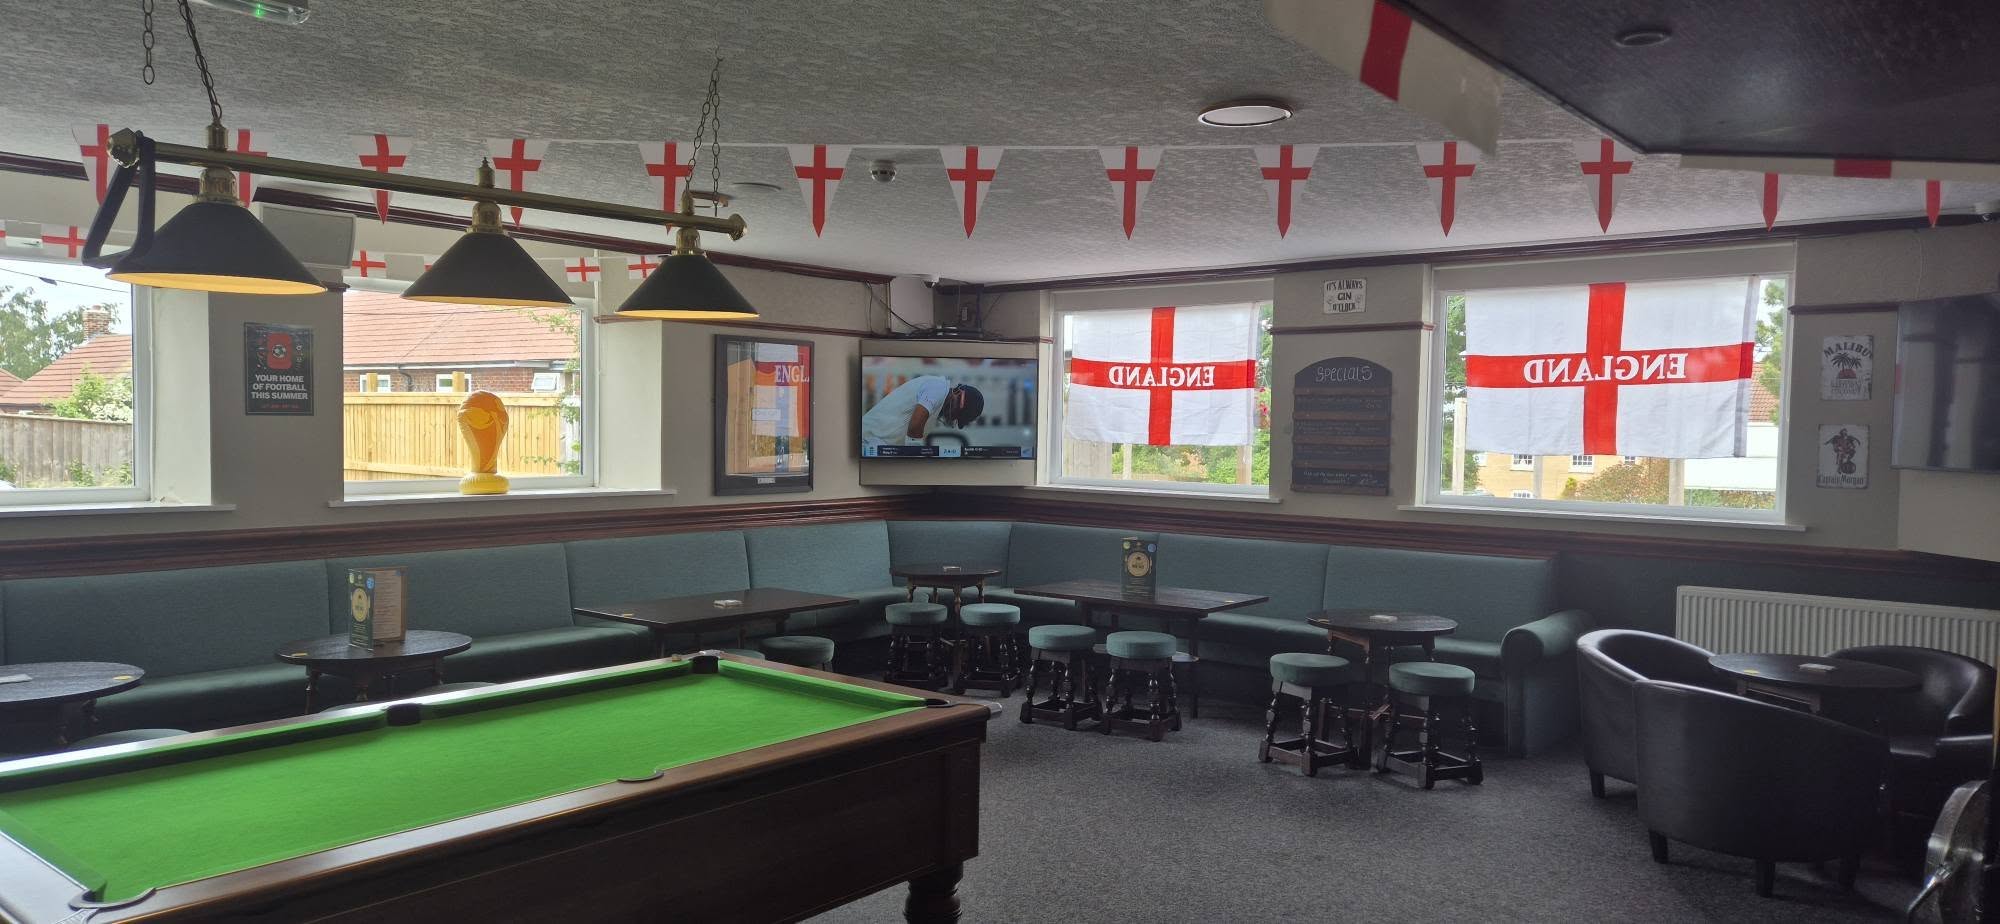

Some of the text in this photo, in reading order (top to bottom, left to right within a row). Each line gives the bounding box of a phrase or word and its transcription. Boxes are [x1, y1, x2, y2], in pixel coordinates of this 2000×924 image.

[1337, 279, 1363, 290] ALWAYS
[1337, 292, 1352, 301] GIN
[1823, 341, 1873, 359] MALIBU
[255, 374, 304, 383] YOUR HOME
[252, 383, 307, 391] OF FOOTBALL
[251, 391, 308, 400] THIS SUMMER
[1840, 474, 1864, 485] Morgan
